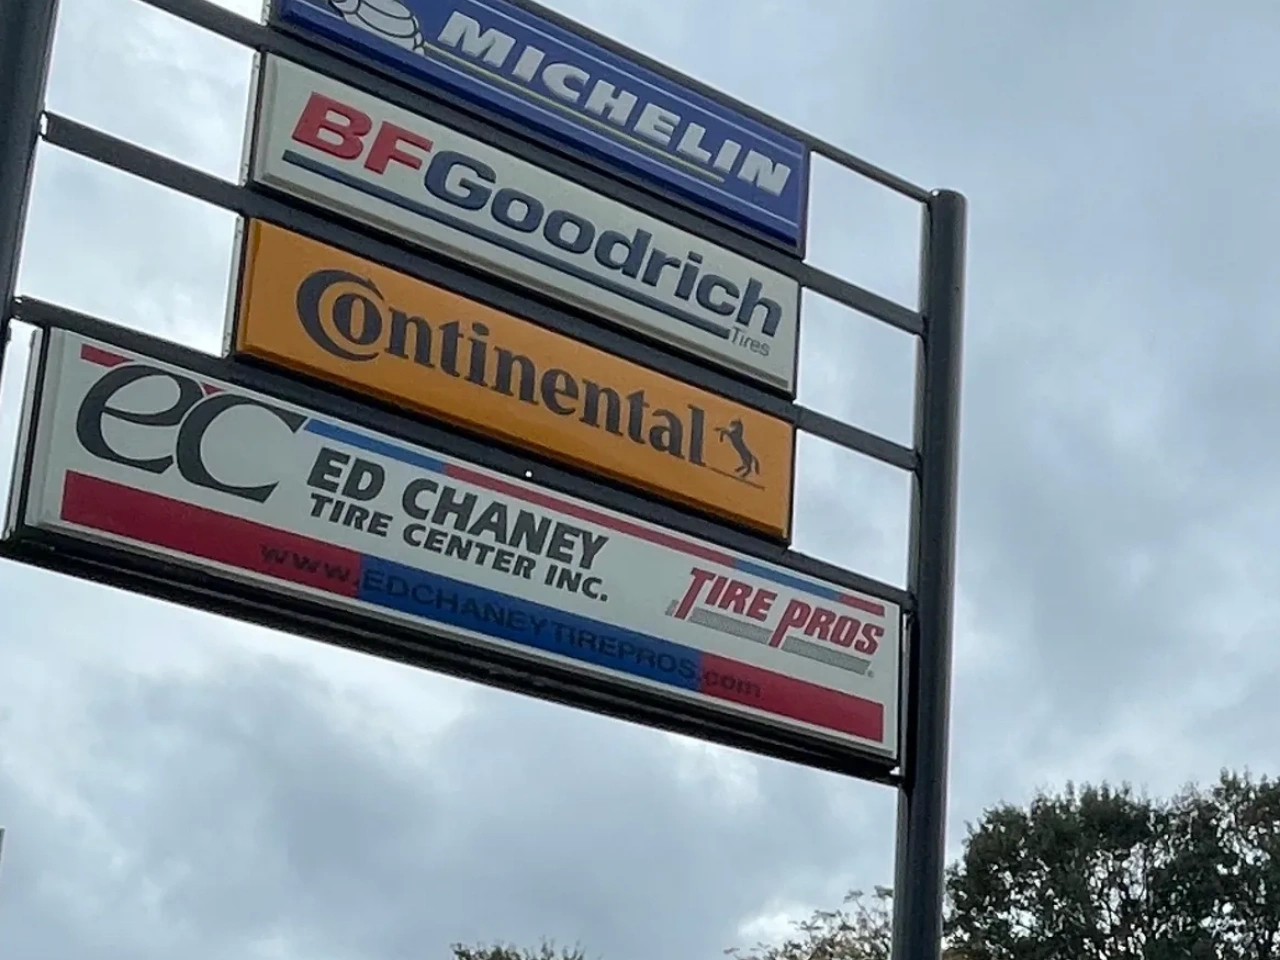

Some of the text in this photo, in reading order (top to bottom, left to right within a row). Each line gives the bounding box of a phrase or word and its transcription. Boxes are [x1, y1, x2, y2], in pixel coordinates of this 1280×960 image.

[437, 10, 792, 198] MICHELIN
[291, 91, 783, 338] BFGoodrich
[295, 269, 706, 467] Continental
[729, 325, 771, 357] Tires
[306, 447, 609, 570] ED CHANEY
[309, 492, 609, 602] TIRE CENTER INC.
[674, 567, 885, 656] TIRE PROS
